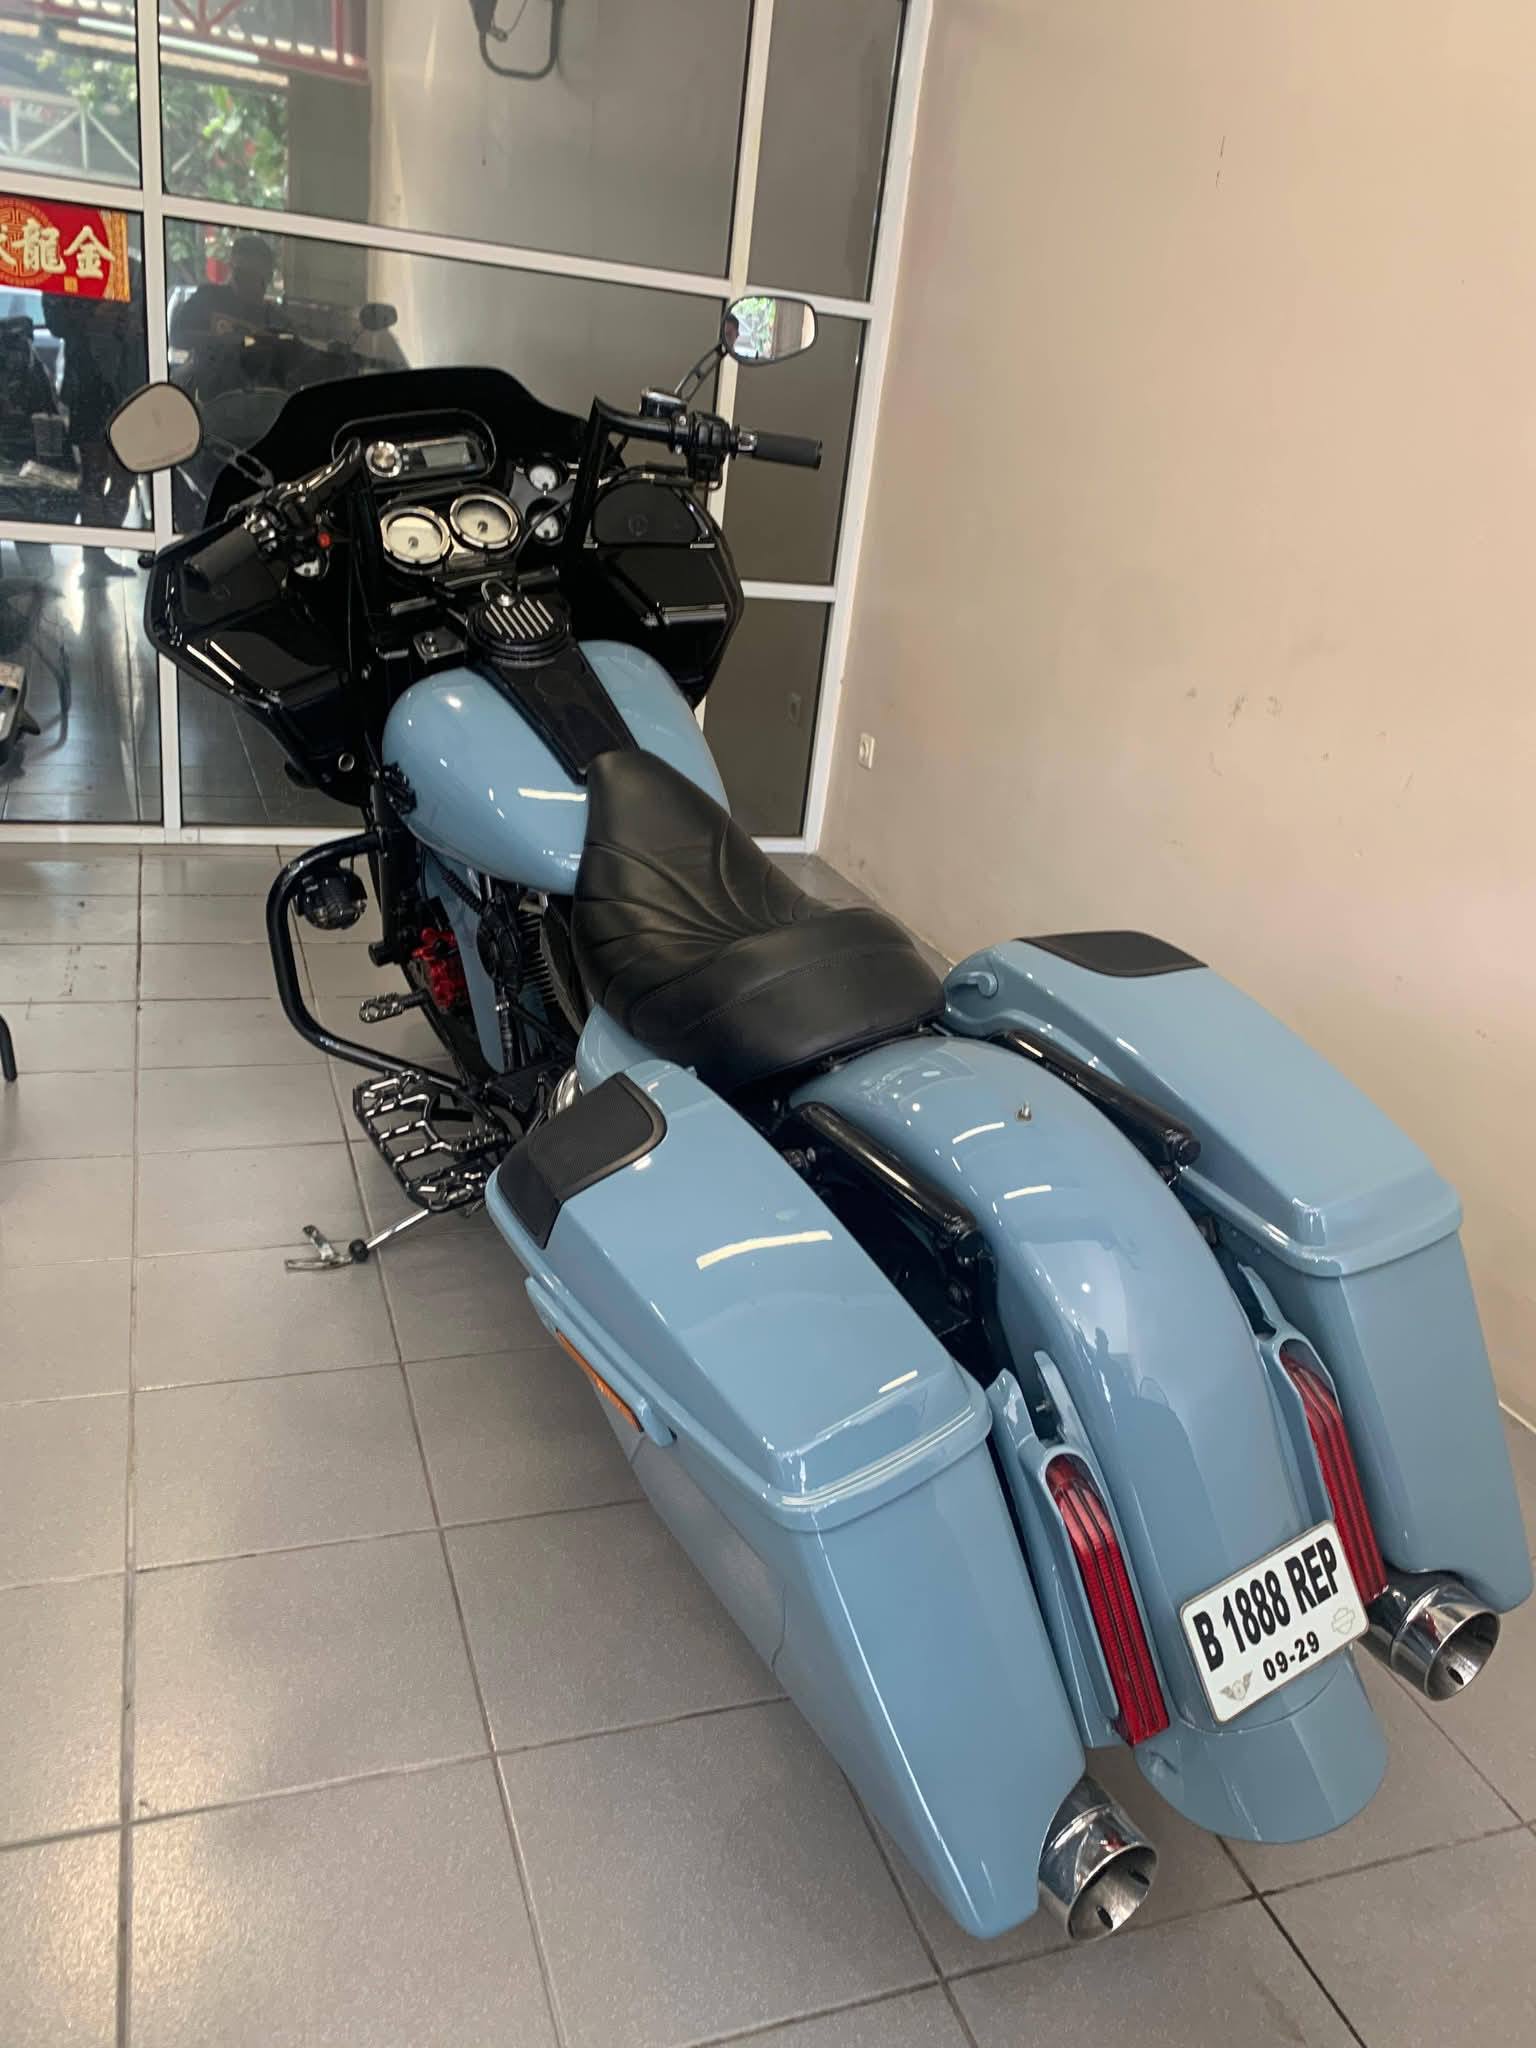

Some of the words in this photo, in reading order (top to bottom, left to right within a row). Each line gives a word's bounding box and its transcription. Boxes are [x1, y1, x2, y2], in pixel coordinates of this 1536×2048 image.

[1192, 1611, 1224, 1672] B
[1222, 1570, 1291, 1653] 1888
[1284, 1537, 1339, 1615] REP
[1262, 1631, 1320, 1681] 09-29
